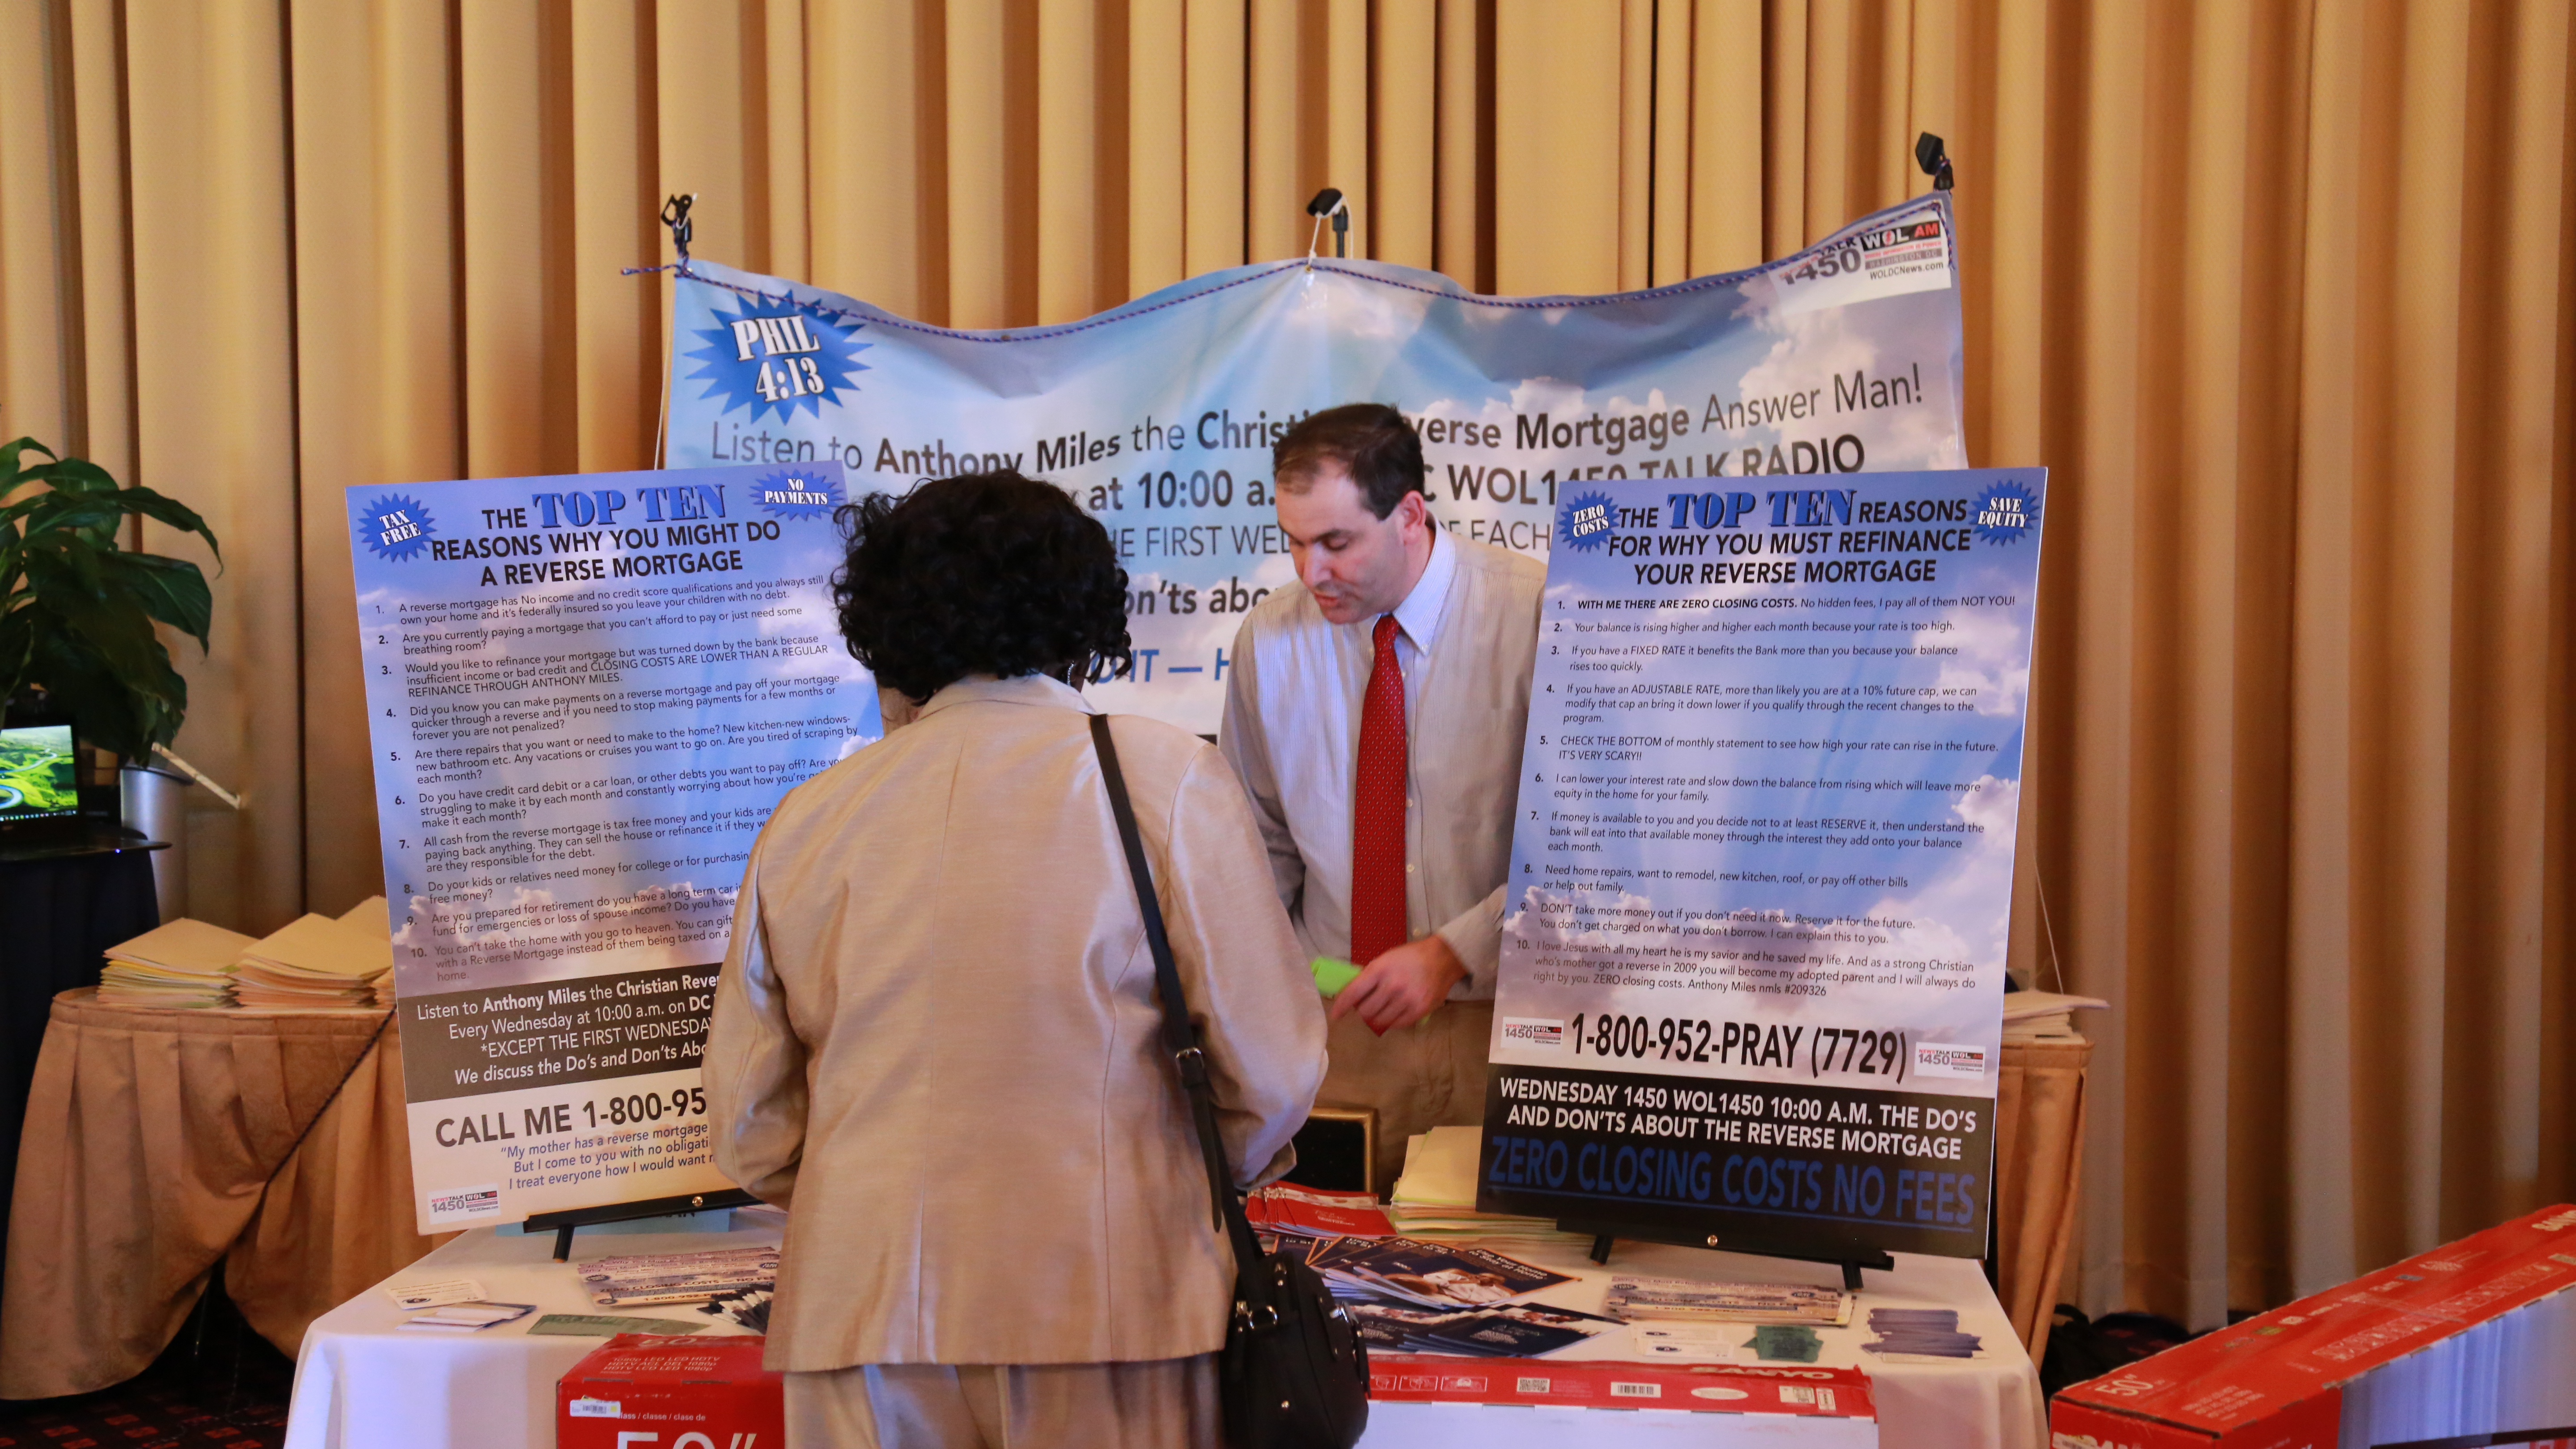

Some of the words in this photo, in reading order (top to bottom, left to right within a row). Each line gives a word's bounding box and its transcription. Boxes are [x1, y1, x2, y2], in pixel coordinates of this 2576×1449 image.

[1864, 229, 1909, 249] WOL
[1914, 223, 1938, 237] AM
[1870, 262, 1944, 280] WOLDCNews.com
[730, 314, 821, 361] PHIL
[755, 356, 825, 403] 4:13
[712, 421, 815, 462] Listen
[828, 436, 862, 470] to
[874, 438, 1023, 476] Anthony
[1037, 431, 1121, 473] Miles
[1132, 416, 1185, 451] the
[1517, 408, 1690, 455] Mortgage
[1702, 389, 1821, 433] Answer
[1834, 363, 1923, 413] Man!
[1743, 434, 1864, 476] RADIO
[764, 491, 828, 505] PAYMENTS
[788, 478, 804, 491] NO
[1089, 477, 1123, 511] at
[1138, 470, 1233, 508] 10:00
[379, 509, 410, 530] TAX
[481, 508, 528, 530] THE
[531, 489, 627, 529] TOP
[636, 483, 726, 523] TEN
[1573, 504, 1607, 524] ZERO
[1616, 507, 1659, 529] THE
[1667, 491, 1757, 530] TOP
[1766, 489, 1858, 528] TEN
[1859, 499, 1968, 523] REASONS
[1978, 511, 2029, 529] EQUITY
[1989, 497, 2022, 513] SAVE
[380, 523, 421, 546] FREE
[430, 534, 542, 561] REASONS
[548, 530, 603, 554] WHY
[608, 527, 659, 550] YOU
[666, 522, 739, 547] MIGHT
[746, 520, 780, 542] DO
[1147, 525, 1222, 557] FIRST
[1573, 516, 1609, 537] COSTS
[1607, 533, 1652, 557] FOR
[1658, 534, 1710, 556] WHY
[1716, 533, 1763, 555] YOU
[1770, 531, 1833, 554] MUST
[1839, 529, 1971, 553] REFINANCE
[480, 566, 498, 587] A
[504, 559, 606, 585] REVERSE
[612, 550, 743, 578] MORTGAGE
[1634, 563, 1694, 585] YOUR
[1700, 562, 1797, 584] REVERSE
[1804, 559, 1936, 583] MORTGAGE
[408, 683, 472, 698] REFINANCE
[473, 679, 529, 692] THROUGH
[532, 675, 586, 688] ANTHONY
[589, 672, 623, 683] MILES.
[1559, 750, 1576, 760] IT'S
[1578, 750, 1603, 760] VERY
[1605, 750, 1642, 761] SCARY!!
[1555, 879, 1575, 891] help
[1578, 882, 1593, 891] out
[1596, 880, 1624, 894] family.
[417, 1004, 459, 1020] Listen
[462, 1002, 479, 1015] to
[483, 994, 544, 1013] Anthony
[548, 987, 587, 1005] Miles
[589, 983, 613, 1000] the
[616, 978, 678, 997] Christian
[449, 1023, 488, 1039] Every
[491, 1011, 572, 1034] Wednesday
[577, 1010, 591, 1025] at
[594, 1003, 632, 1022] 10:00
[636, 1004, 665, 1018] a.m.
[668, 1001, 686, 1014] on
[689, 994, 711, 1012] DC
[548, 1032, 579, 1051] THE
[583, 1027, 622, 1046] FIRST
[1505, 1028, 1533, 1038] 1450
[1572, 1012, 1804, 1068] 1-800-952-PRAY
[1811, 1027, 1907, 1083] (7729)
[454, 1068, 479, 1085] We
[483, 1064, 534, 1082] discuss
[537, 1058, 561, 1075] the
[566, 1053, 597, 1072] Do's
[601, 1048, 627, 1068] and
[631, 1044, 677, 1063] Don'ts
[1500, 1077, 1618, 1105] WEDNESDAY
[1624, 1086, 1667, 1109] 1450
[1673, 1089, 1764, 1116] WOL1450
[1771, 1097, 1822, 1121] 10:00
[1826, 1101, 1873, 1125] A.M.
[1879, 1104, 1919, 1128] THE
[1925, 1108, 1976, 1133] DO'S
[436, 1112, 515, 1148] CALL
[524, 1103, 572, 1136] ME
[529, 1140, 571, 1155] mother
[575, 1136, 593, 1149] has
[597, 1137, 604, 1146] a
[607, 1131, 649, 1145] reverse
[652, 1124, 708, 1139] mortgage
[1507, 1104, 1550, 1127] AND
[1555, 1107, 1627, 1133] DON'TS
[1630, 1113, 1699, 1138] ABOUT
[1704, 1118, 1742, 1142] THE
[1747, 1122, 1835, 1150] REVERSE
[1841, 1129, 1962, 1160] MORTGAGE
[1489, 1136, 1569, 1187] ZERO
[1577, 1143, 1712, 1200] CLOSING
[1722, 1154, 1824, 1210] COSTS
[1833, 1164, 1886, 1215] NO
[1895, 1169, 1975, 1222] FEES
[432, 1200, 465, 1212] 1450
